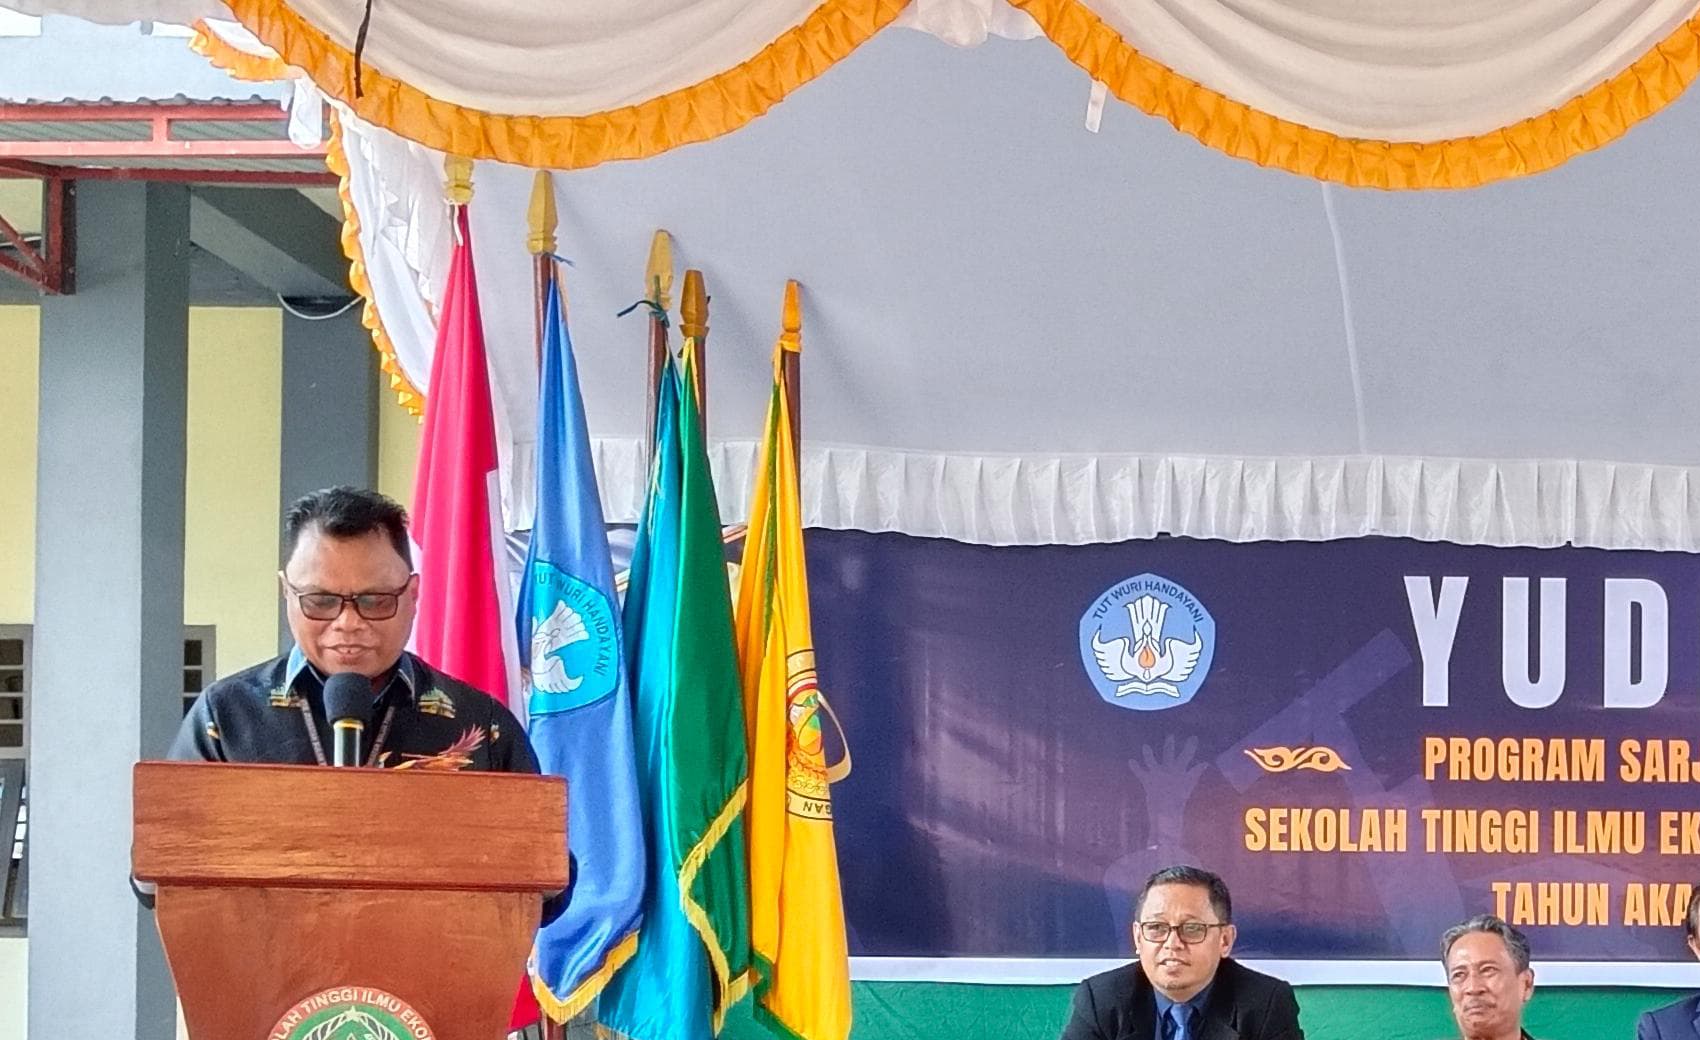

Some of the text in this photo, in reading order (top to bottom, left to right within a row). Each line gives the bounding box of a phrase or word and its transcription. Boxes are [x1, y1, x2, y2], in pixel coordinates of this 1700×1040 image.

[1093, 580, 1204, 623] TUT WURI HANDAYANI
[584, 600, 611, 677] HANDAYANI
[1425, 737, 1605, 782] PROGRAM
[802, 800, 832, 815] GAN
[1245, 808, 1407, 852] SEKOLAH
[1421, 809, 1539, 854] TINGGI
[1553, 810, 1645, 854] ILMU
[1492, 882, 1609, 926] TAHUN
[300, 988, 358, 1014] TINGGI
[361, 990, 401, 1013] ILMU
